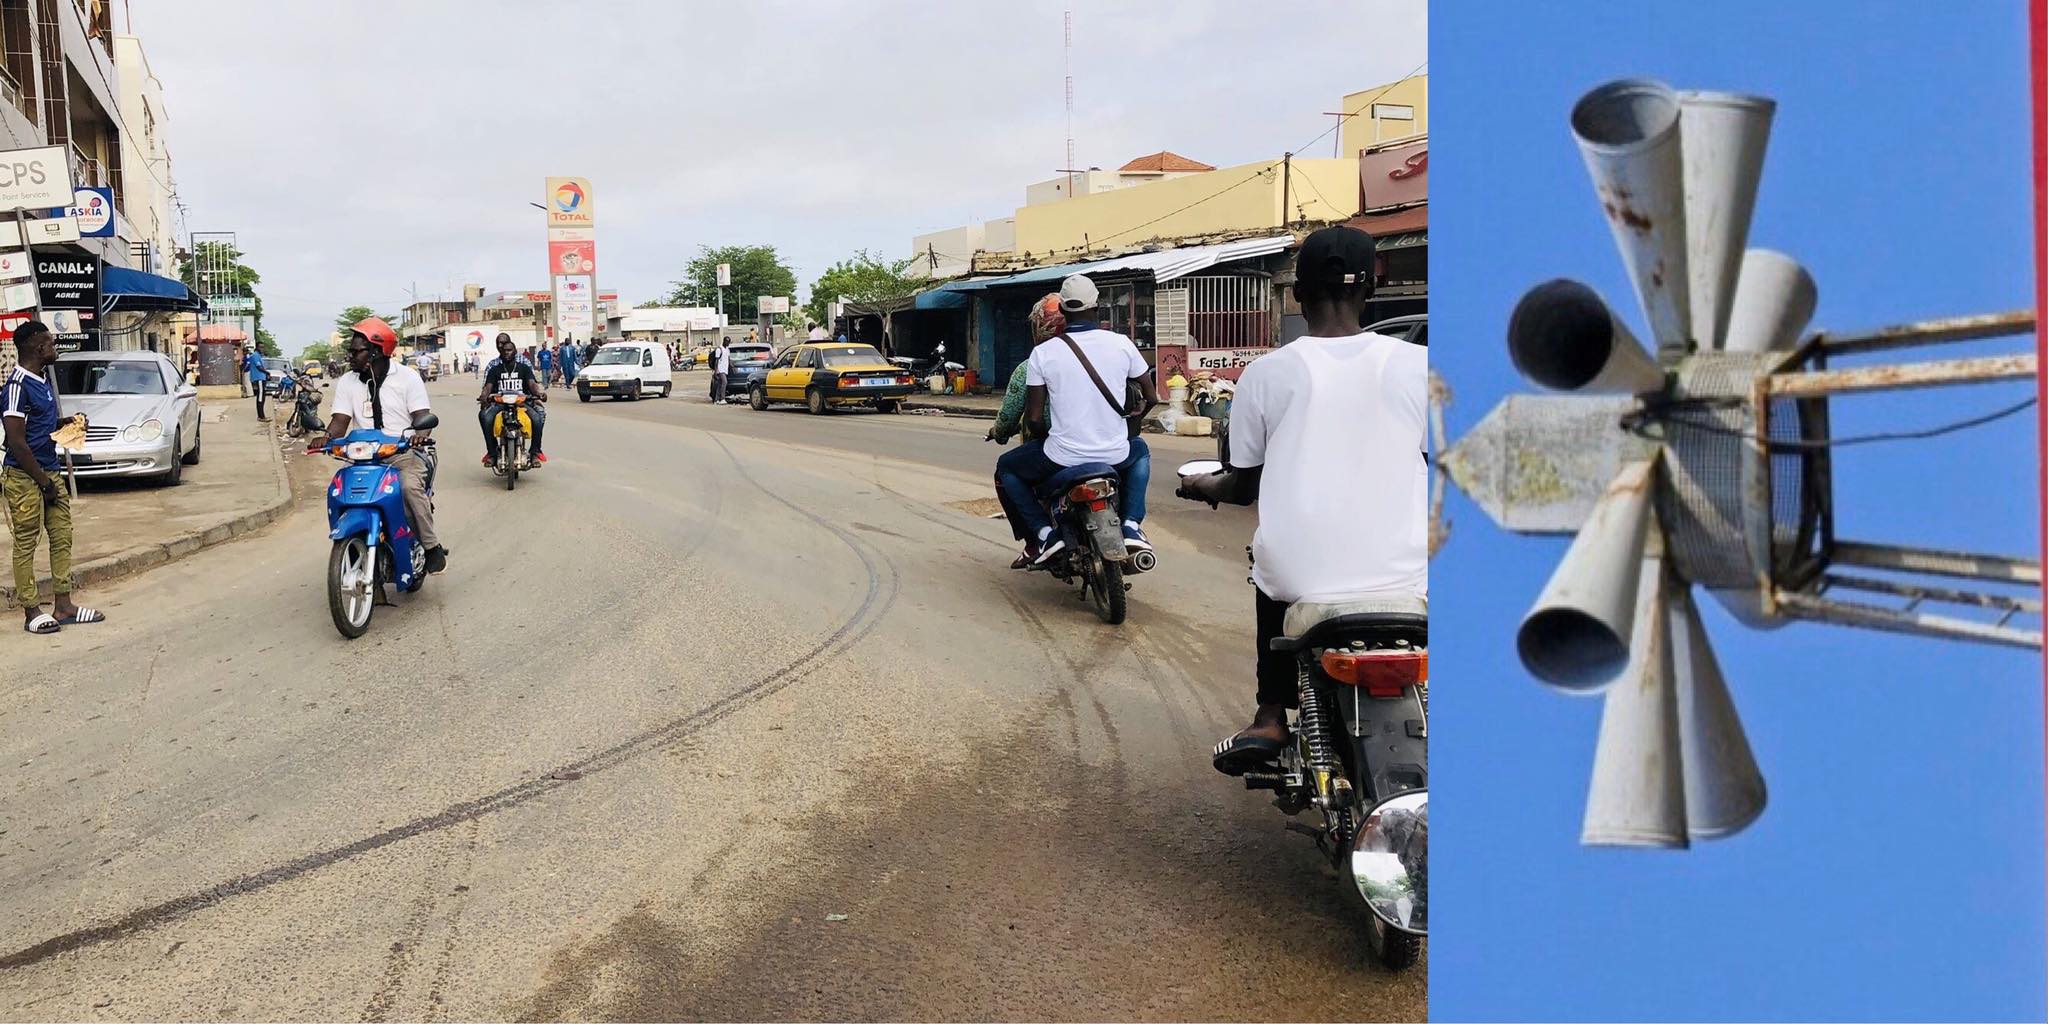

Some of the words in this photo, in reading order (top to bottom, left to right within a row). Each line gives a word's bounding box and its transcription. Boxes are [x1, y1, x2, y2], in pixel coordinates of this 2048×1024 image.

[70, 208, 103, 216] ASKIA
[551, 212, 592, 221] TOTAL
[38, 262, 95, 274] CANAL+
[527, 293, 552, 302] TOTA
